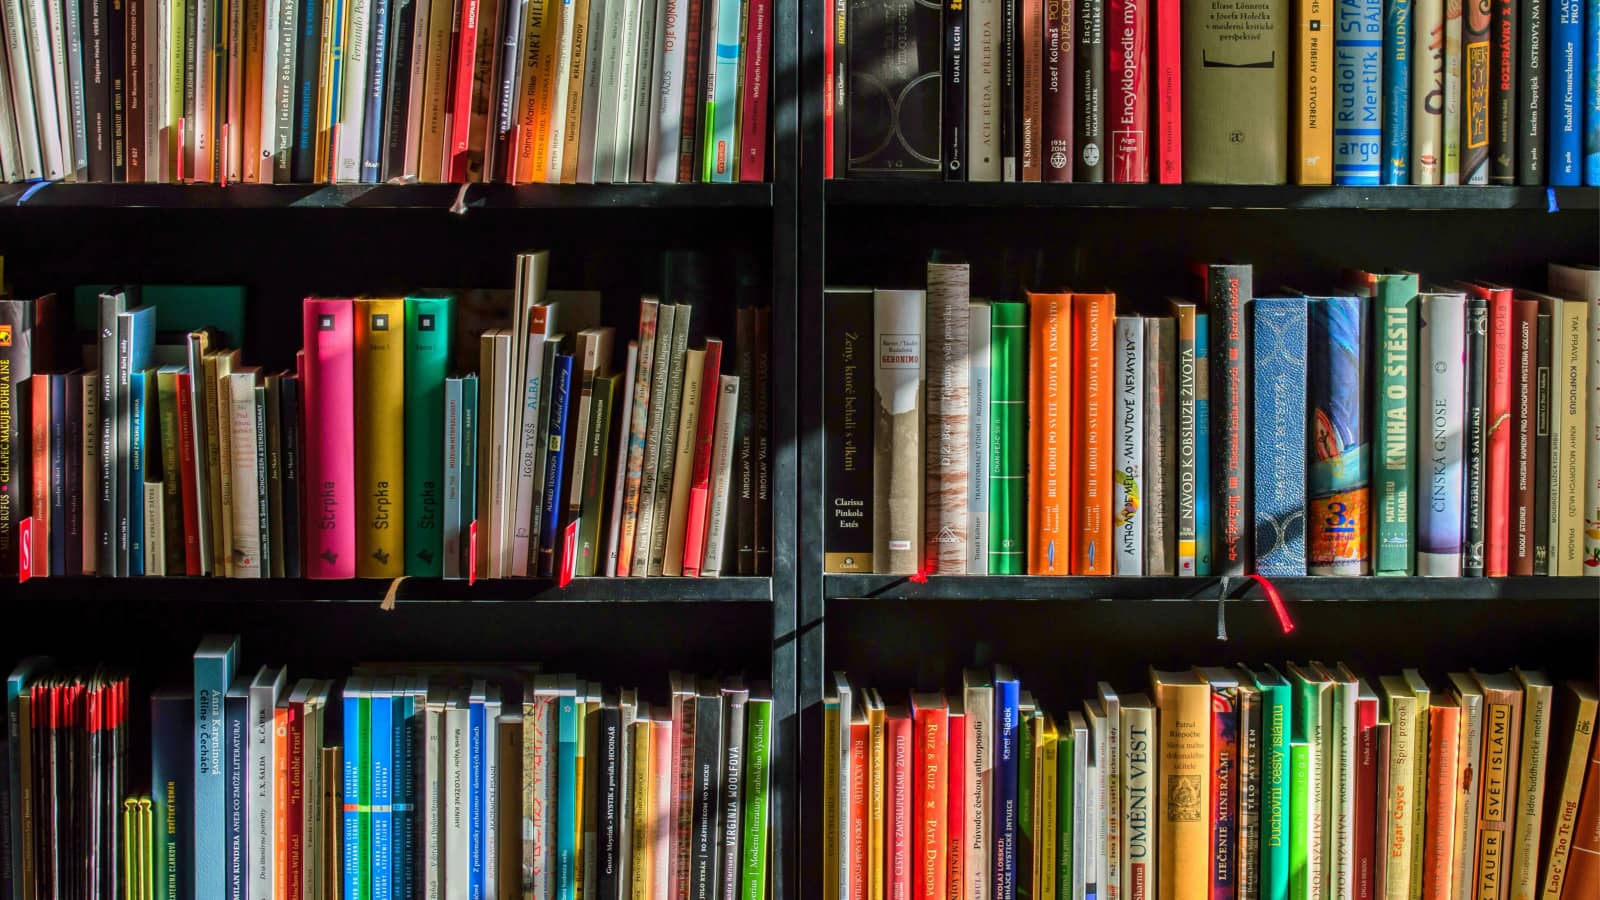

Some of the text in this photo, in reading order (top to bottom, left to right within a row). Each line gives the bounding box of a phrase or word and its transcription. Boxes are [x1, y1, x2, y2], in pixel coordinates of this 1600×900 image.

[1049, 28, 1058, 92] Josef Kolmaš
[1531, 21, 1540, 68] OSTROVY,
[1121, 28, 1136, 124] Encyklopedie
[1338, 51, 1355, 122] Rudolf
[1339, 142, 1378, 161] argo
[1384, 306, 1407, 469] KNIHA O ŠTĚSTÍ
[1569, 366, 1577, 415] KONFUCIUS
[523, 452, 533, 477] IGOR
[528, 377, 539, 409] ALBA
[1180, 348, 1193, 519] NÁVOD K OBSLUZE ŽIVOTA
[0, 444, 9, 482] CHLAPEC
[1431, 399, 1446, 512] ČÍNSKÁ GNOSE
[835, 498, 863, 506] Clarissa
[835, 509, 863, 517] Pinkola
[1533, 700, 1544, 737] meditace
[292, 756, 300, 786] double
[1003, 738, 1011, 759] Karel
[1528, 740, 1540, 792] buddhistické
[1124, 724, 1147, 860] UMĚNÍ VÉST
[1269, 704, 1284, 847] Duchovní cesty islámu
[234, 799, 240, 810] CO
[726, 801, 737, 846] VIRGINIA
[1393, 785, 1405, 819] Cayce
[1484, 710, 1505, 890] TAUER ISLÁMU
[973, 810, 982, 849] Průvodce
[1392, 824, 1405, 857] Edgar
[1555, 838, 1567, 857] Tao
[1217, 827, 1227, 880] LIEČENIE
